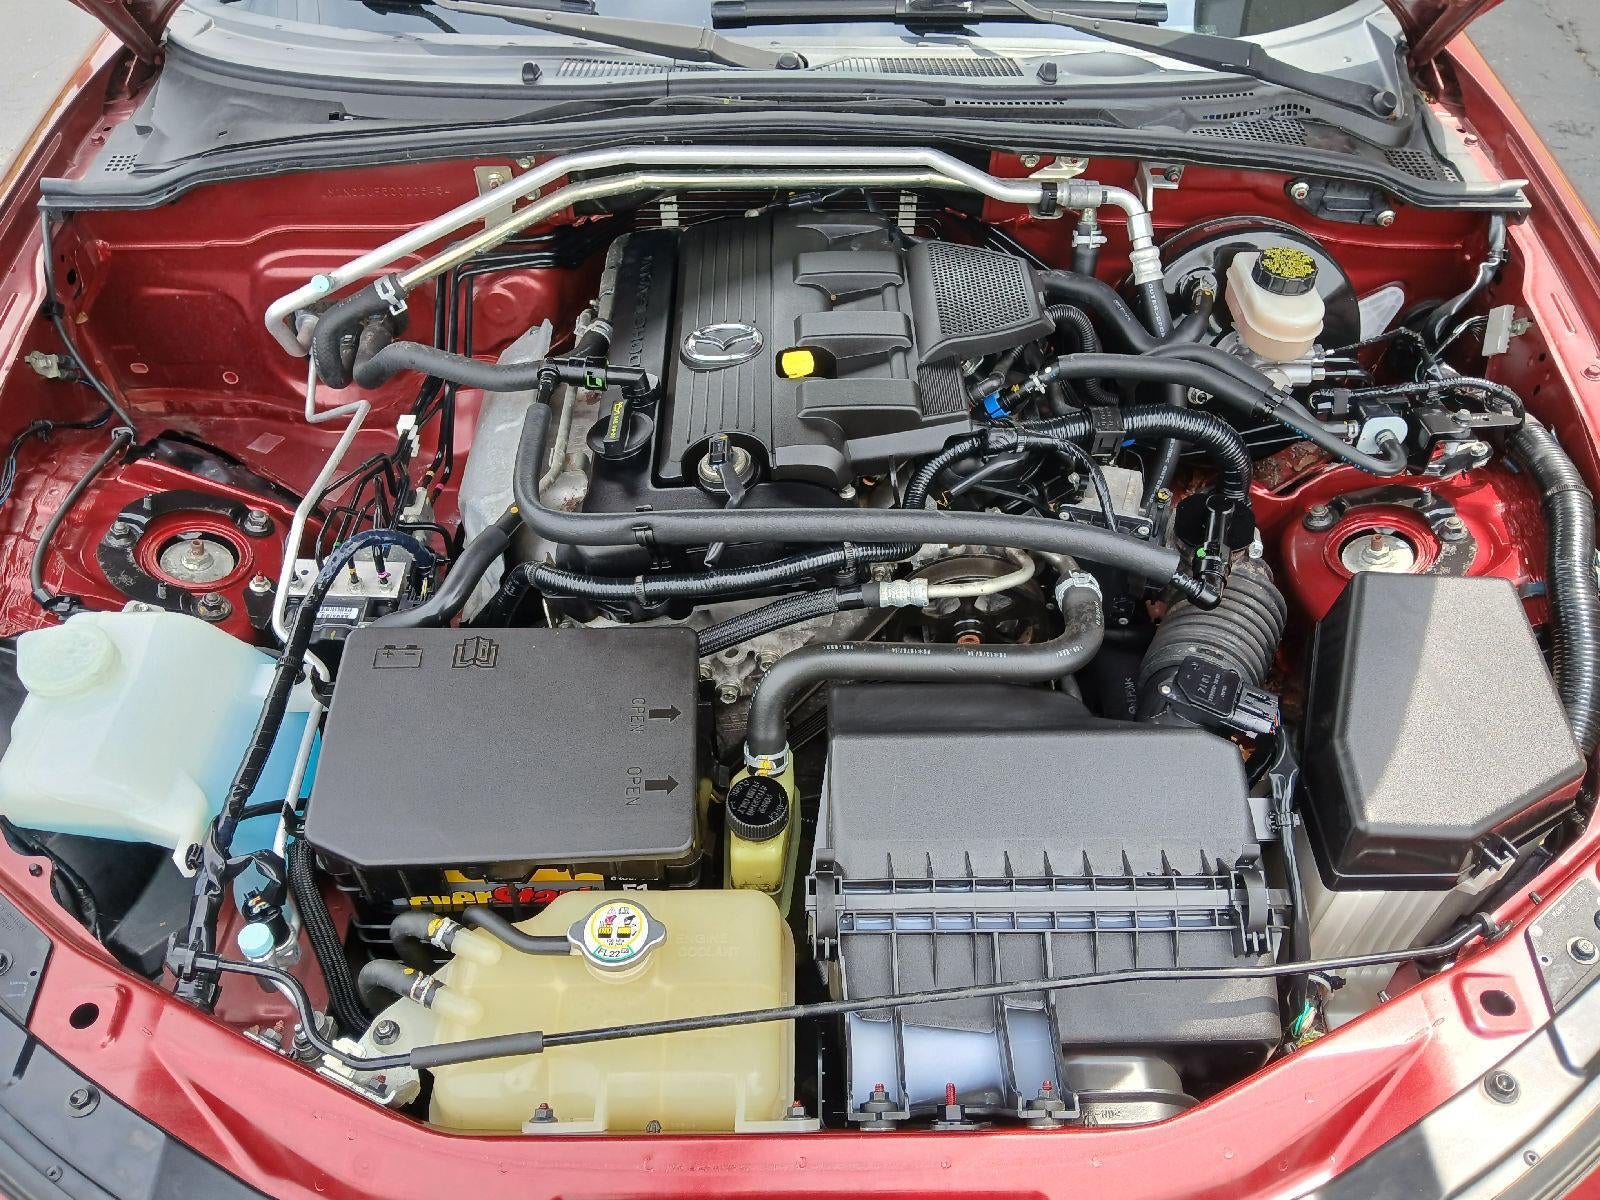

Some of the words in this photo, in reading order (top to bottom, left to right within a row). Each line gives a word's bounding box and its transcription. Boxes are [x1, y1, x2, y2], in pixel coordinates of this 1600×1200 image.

[630, 697, 646, 732] OPEN
[625, 766, 643, 806] OPEN
[598, 947, 620, 958] FL22
